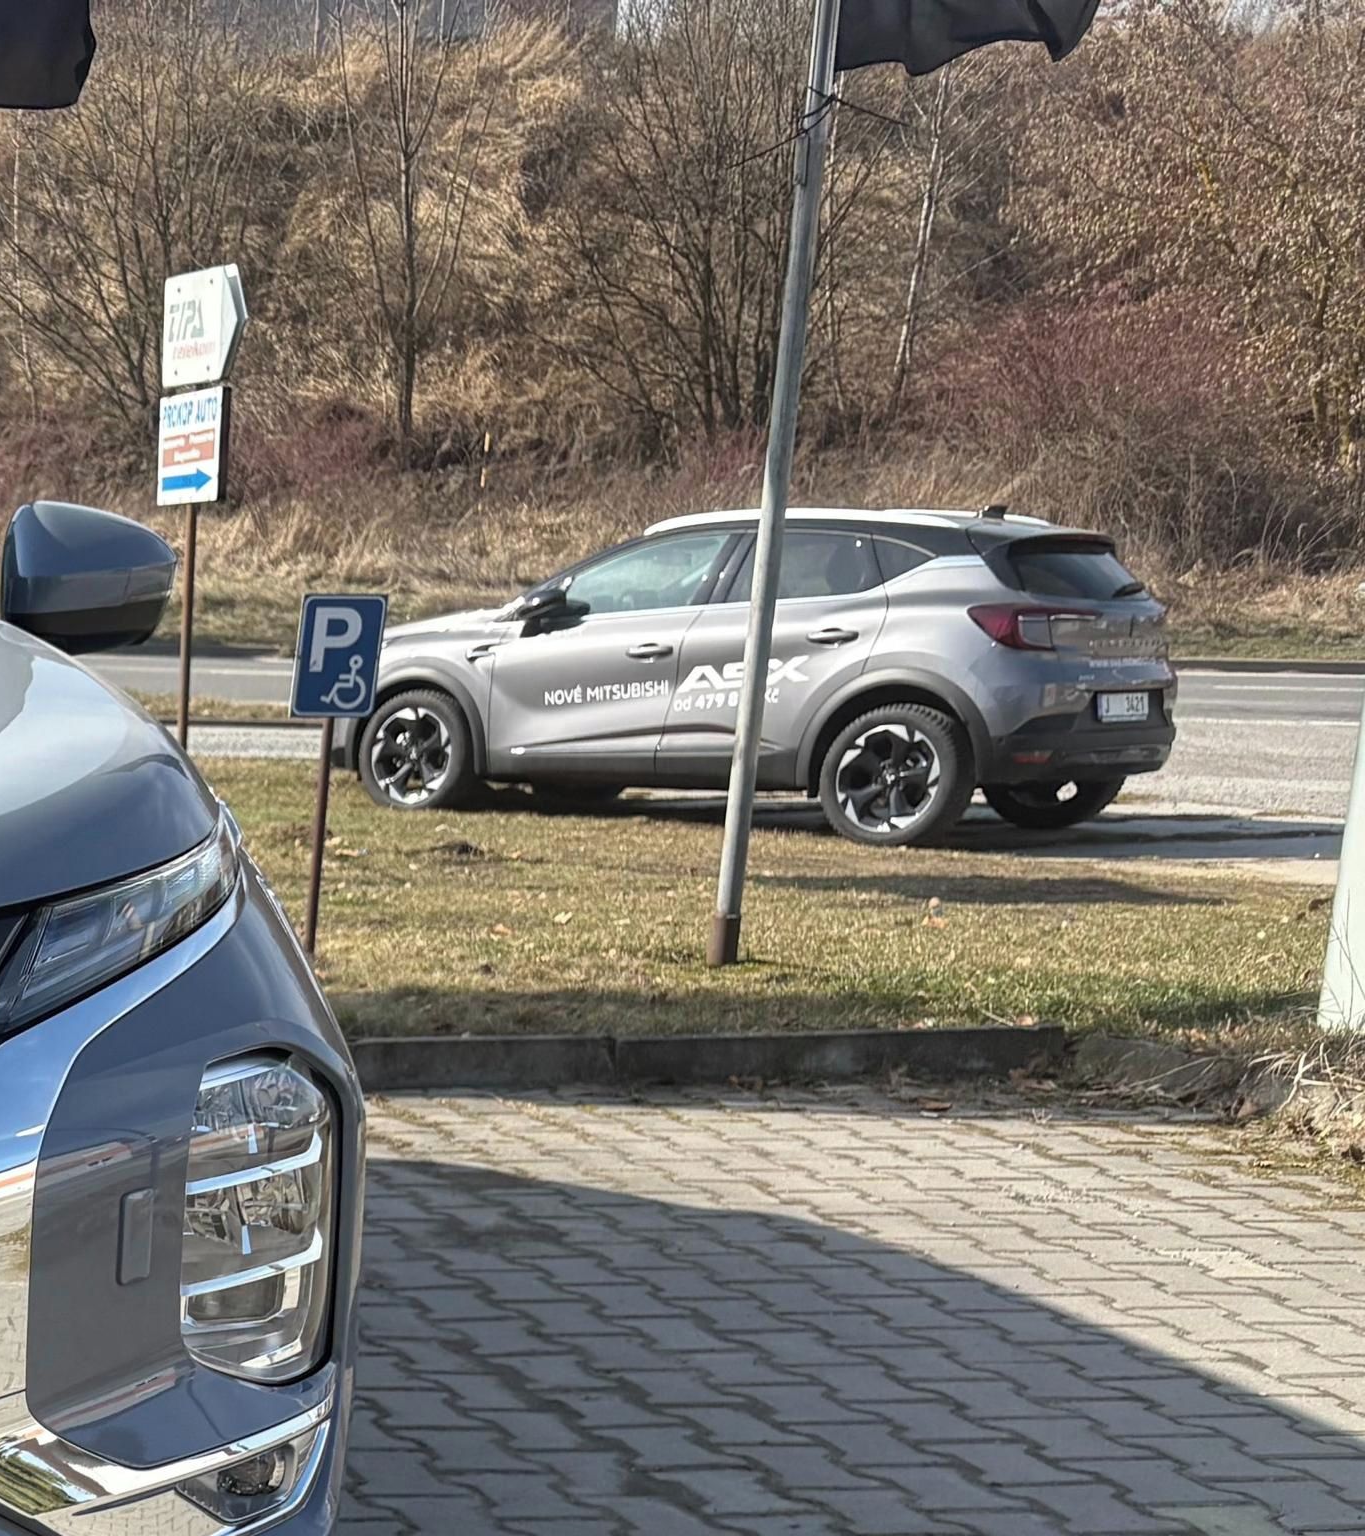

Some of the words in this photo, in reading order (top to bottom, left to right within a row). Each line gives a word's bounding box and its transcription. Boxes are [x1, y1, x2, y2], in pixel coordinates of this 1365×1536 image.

[195, 395, 218, 424] AUTO
[309, 607, 362, 672] P
[544, 684, 582, 706] NOVÉ
[586, 679, 669, 702] MITSUBISHI
[673, 693, 691, 712] od
[694, 691, 725, 711] 479
